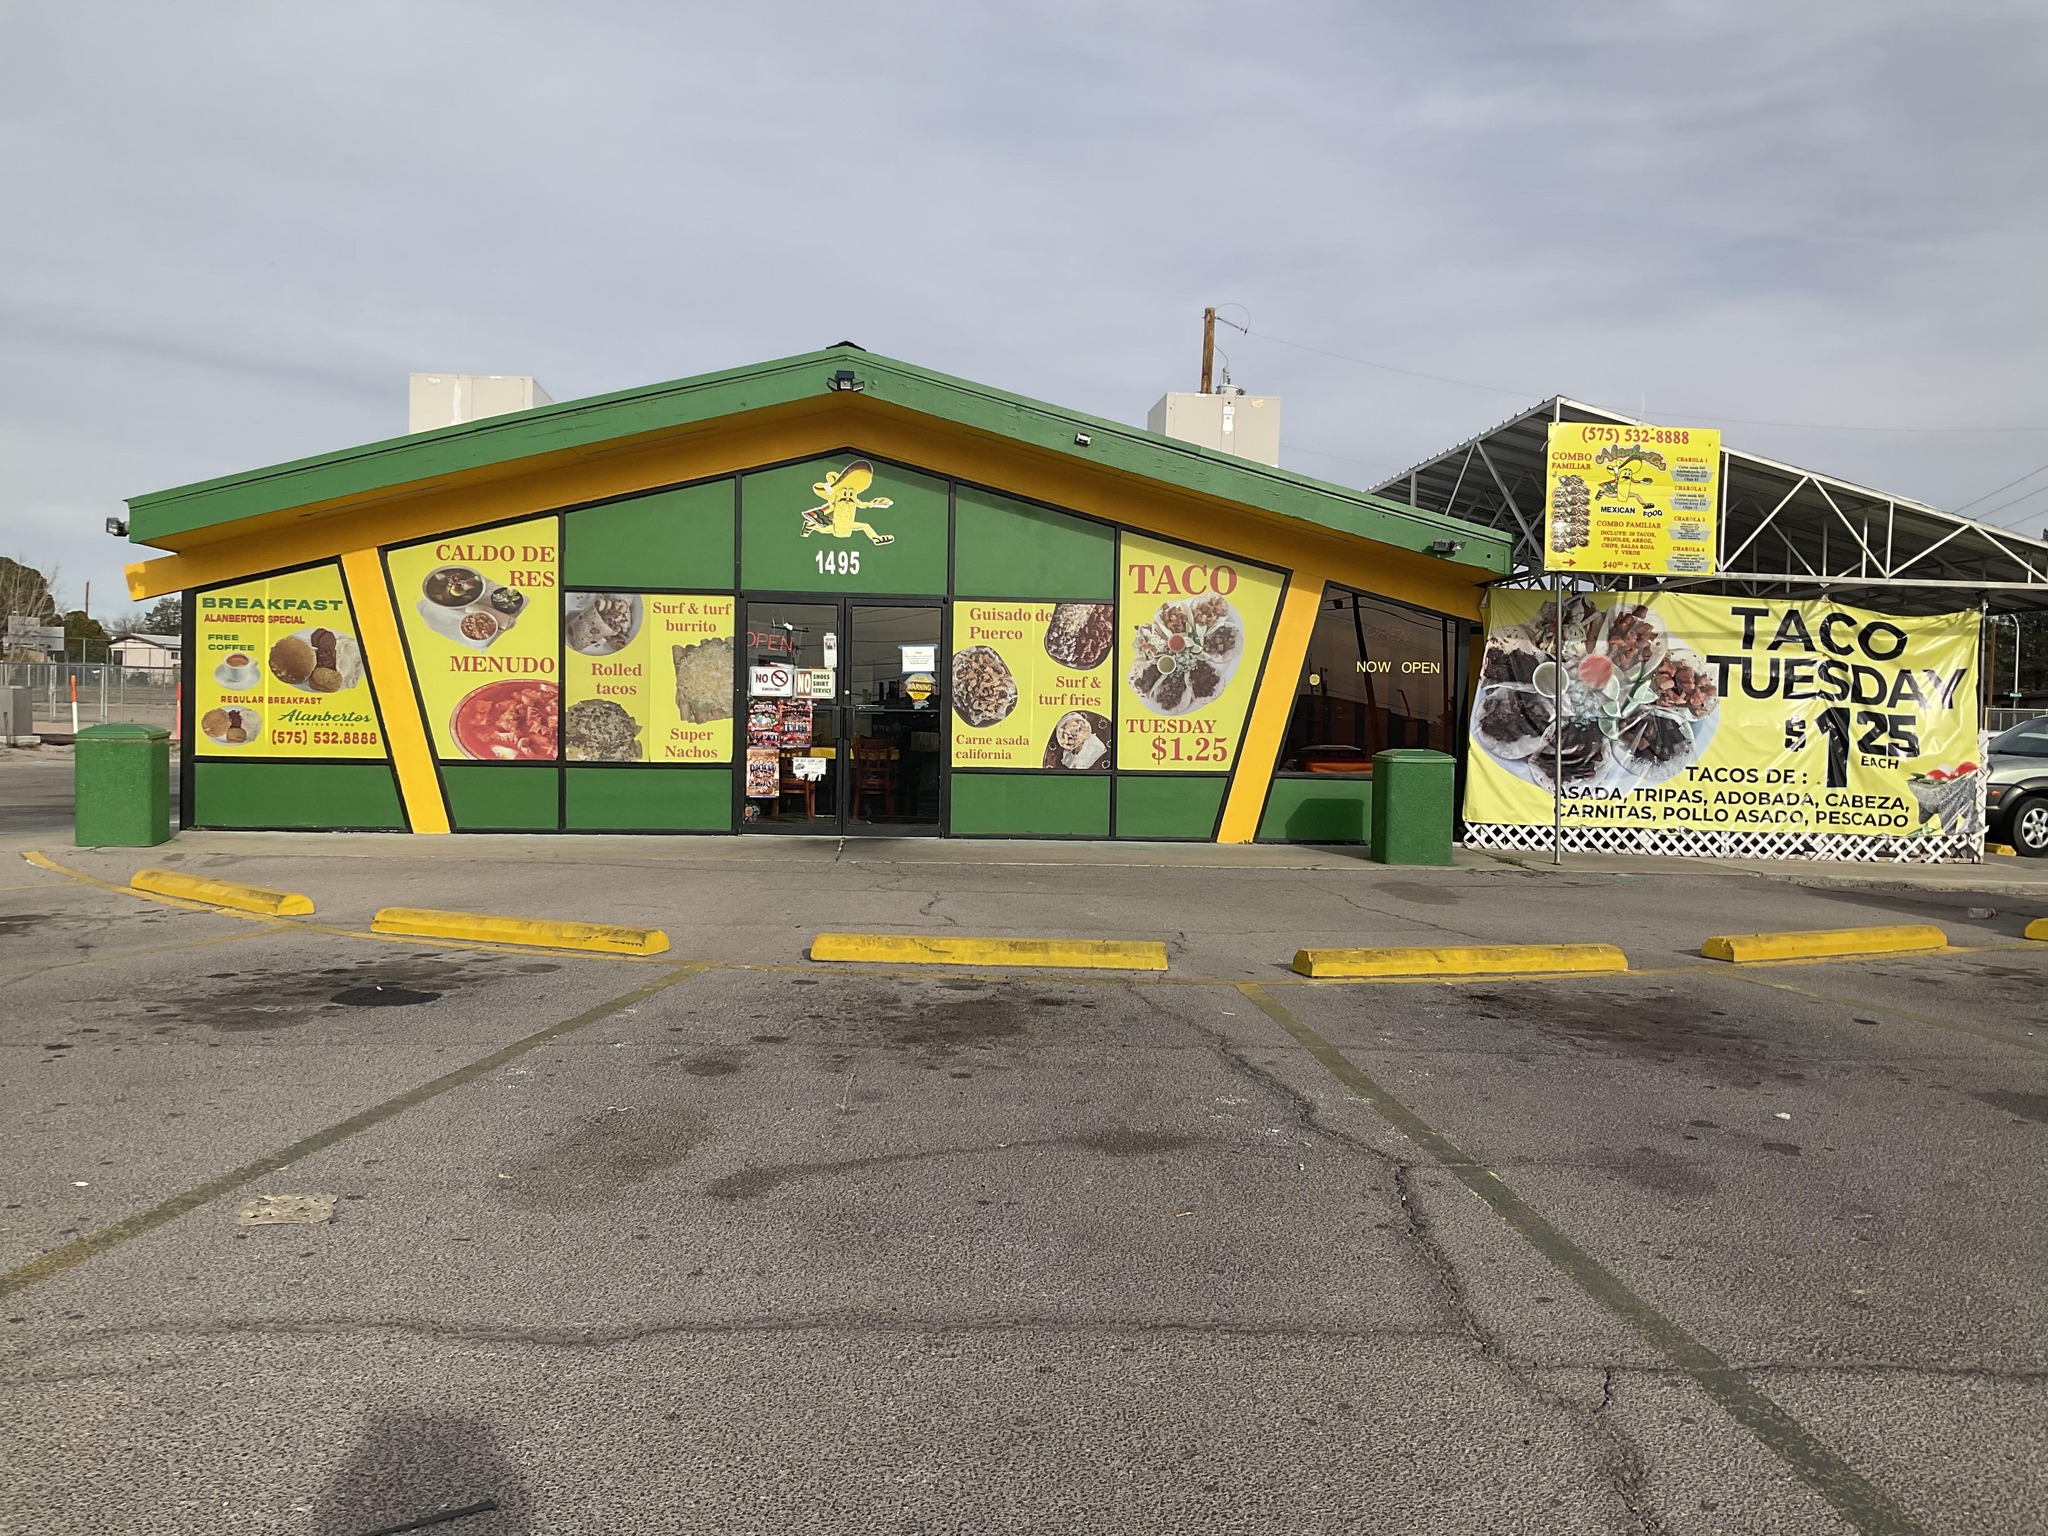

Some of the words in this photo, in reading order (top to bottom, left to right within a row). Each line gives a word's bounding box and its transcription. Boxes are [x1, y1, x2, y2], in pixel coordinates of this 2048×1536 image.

[1582, 427, 1619, 443] (575)
[1624, 429, 1689, 444] 532-8888
[1552, 452, 1592, 460] COMBO
[1552, 462, 1592, 470] FAMILIAR
[1600, 506, 1636, 514] MEXICAN
[1643, 510, 1663, 518] FOOD
[436, 544, 515, 562] CALDO
[522, 546, 556, 562] DE
[816, 550, 860, 574] 1495
[509, 570, 556, 587] RES
[1128, 564, 1238, 596] TACO
[202, 597, 343, 610] BREAKFAST
[653, 602, 686, 614] Surf
[688, 603, 699, 614] &
[704, 603, 732, 616] turf
[204, 614, 264, 624] ALANBERTOS
[268, 615, 305, 624] SPECIAL
[970, 608, 1032, 622] Guisado
[1036, 610, 1052, 622] de
[666, 620, 716, 632] burrito
[969, 626, 1023, 640] Puerco
[1731, 606, 1908, 661] TACO
[450, 656, 556, 674] MENUDO
[591, 663, 642, 676] Rolled
[1356, 660, 1392, 673] NOW
[1402, 662, 1440, 674] OPEN
[756, 674, 768, 683] NO
[797, 673, 812, 694] NO
[1056, 676, 1088, 688] Surf
[1090, 677, 1102, 688] &
[1706, 655, 1968, 710] TUESDAY
[596, 682, 637, 696] tacos
[220, 696, 264, 704] REGULAR
[268, 696, 322, 704] BREAKFAST
[1039, 694, 1068, 706] turf
[1069, 694, 1102, 706] fries
[278, 709, 372, 722] Alanbertos
[1126, 719, 1217, 734] TUESDAY
[272, 730, 308, 746] (575)
[314, 731, 377, 745] 532.8888
[670, 728, 714, 744] Super
[956, 734, 992, 746] Carne
[996, 735, 1030, 746] asada
[664, 746, 718, 758] Nachos
[956, 749, 1012, 760] california
[1152, 736, 1228, 765] $1.25
[1861, 756, 1900, 770] EACH
[1685, 766, 1758, 784] TACOS
[1766, 768, 1796, 784] DE
[1554, 786, 1628, 804] ASADA,
[1634, 788, 1708, 806] TRIPAS,
[1714, 791, 1820, 808] ADOBADA,
[1825, 793, 1910, 812] CABEZA,
[1554, 804, 1657, 822] CARNITAS,
[1663, 806, 1728, 822] POLLO
[1734, 810, 1809, 826] ASADO,
[1816, 811, 1908, 828] PESCADO
